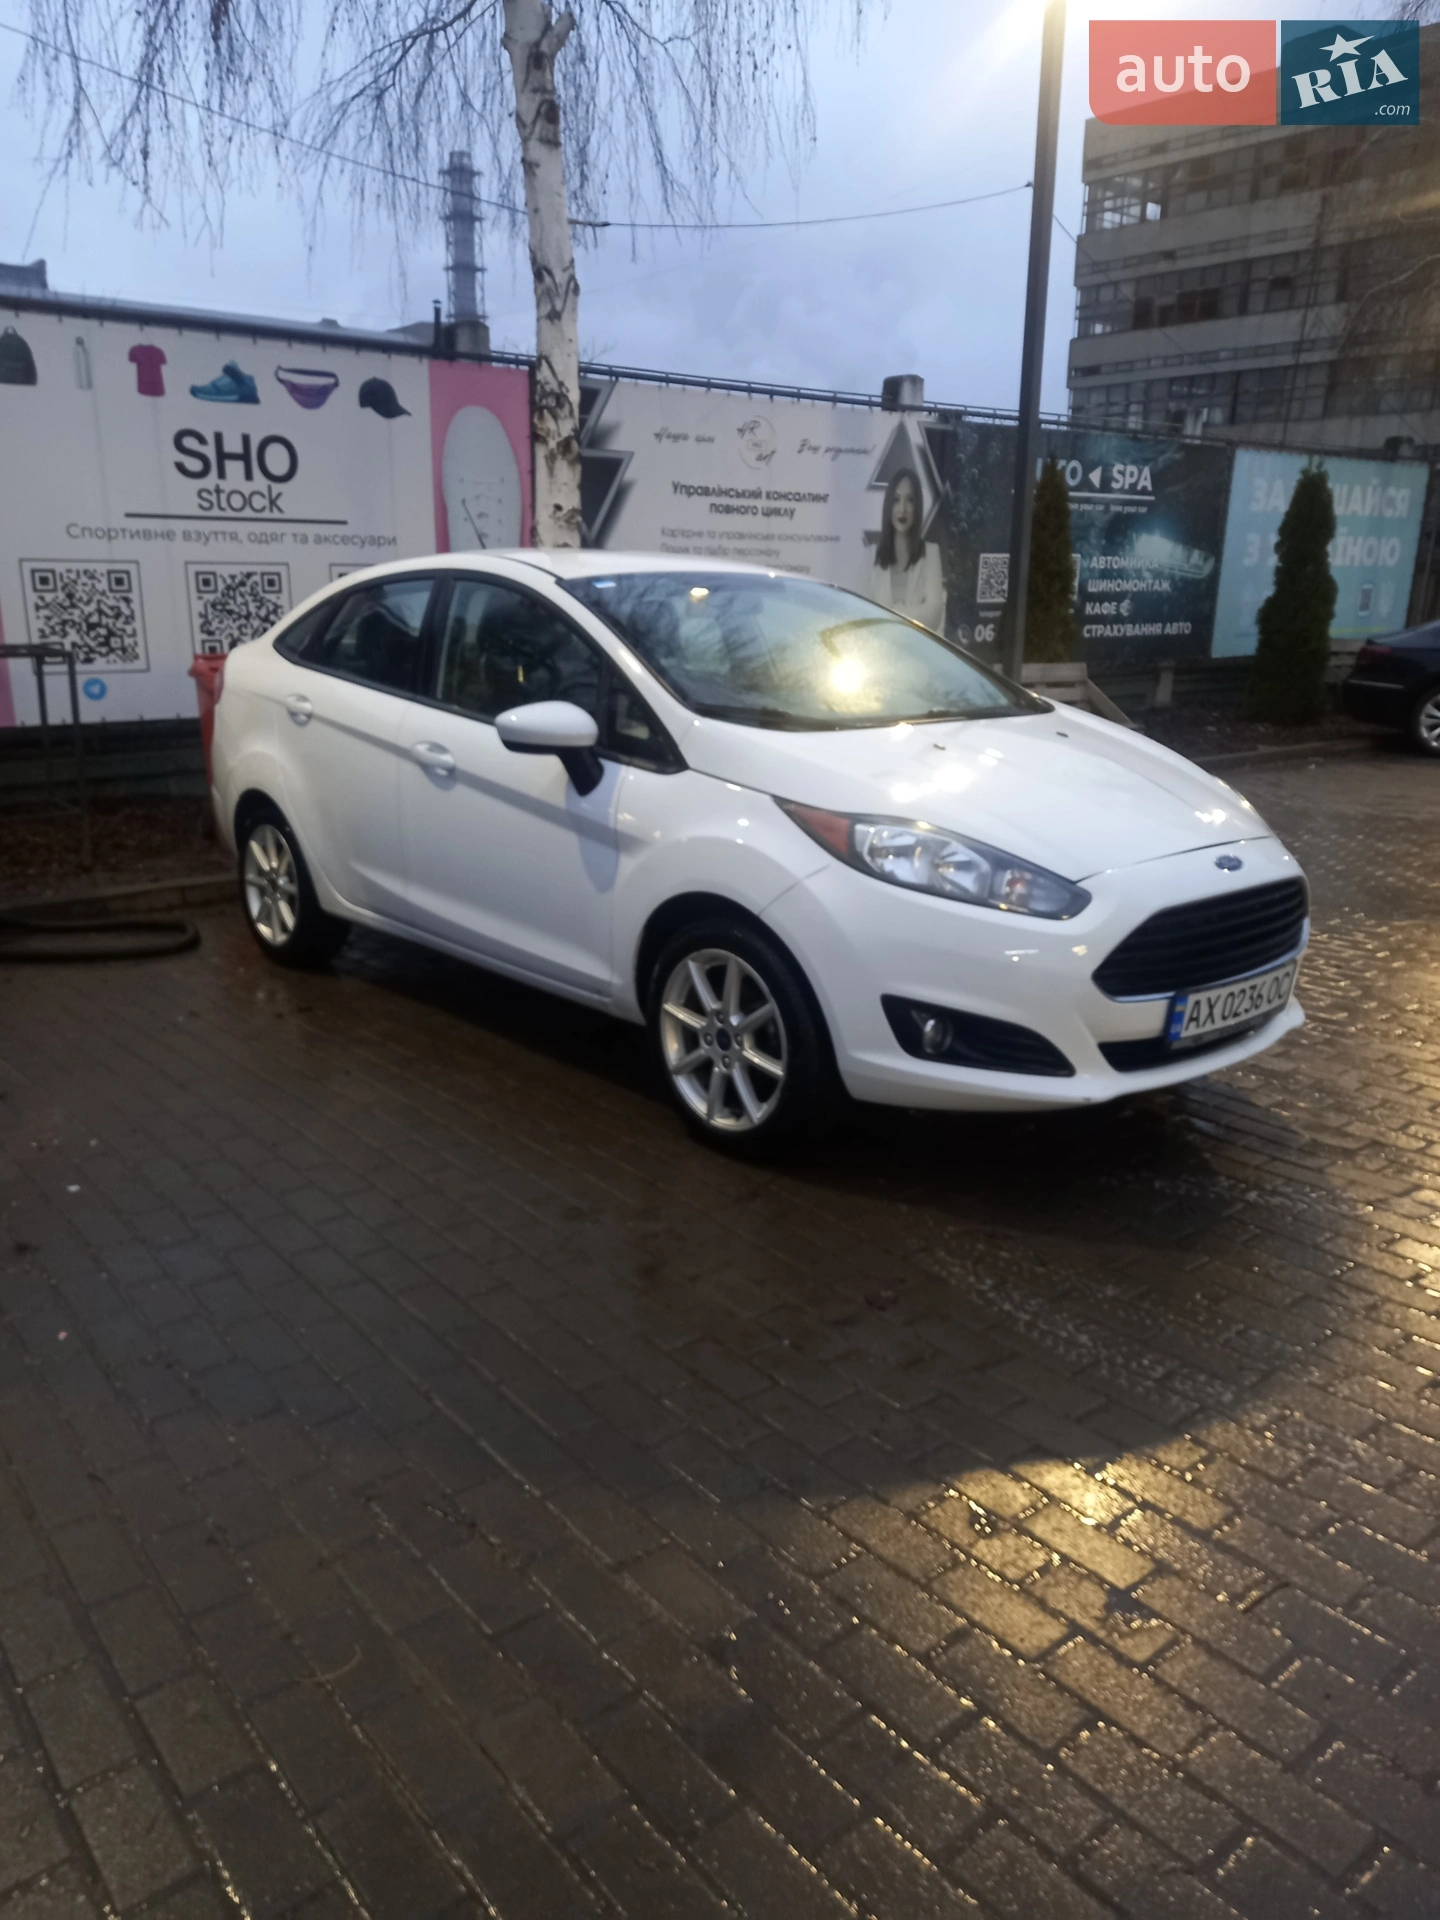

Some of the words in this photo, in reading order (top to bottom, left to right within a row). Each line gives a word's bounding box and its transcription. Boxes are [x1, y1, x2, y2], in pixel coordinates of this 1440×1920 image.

[173, 427, 299, 484] SHO
[1111, 463, 1153, 491] SPA
[196, 482, 285, 514] stock
[671, 480, 763, 500] Управлінський
[765, 488, 830, 504] консалтинг
[709, 502, 759, 517] повного
[761, 505, 796, 520] циклу
[66, 522, 177, 543] Спортивне
[182, 529, 243, 546] взуття,
[247, 530, 287, 546] одяг
[291, 531, 309, 544] та
[314, 533, 398, 549] аксесуари
[1087, 578, 1172, 593] ШИНОМОНТАЖ
[1085, 601, 1118, 615] КАФЕ
[974, 623, 996, 642] 06
[1083, 622, 1163, 638] СТРАХУВАННЯ
[1164, 621, 1193, 636] АВТО
